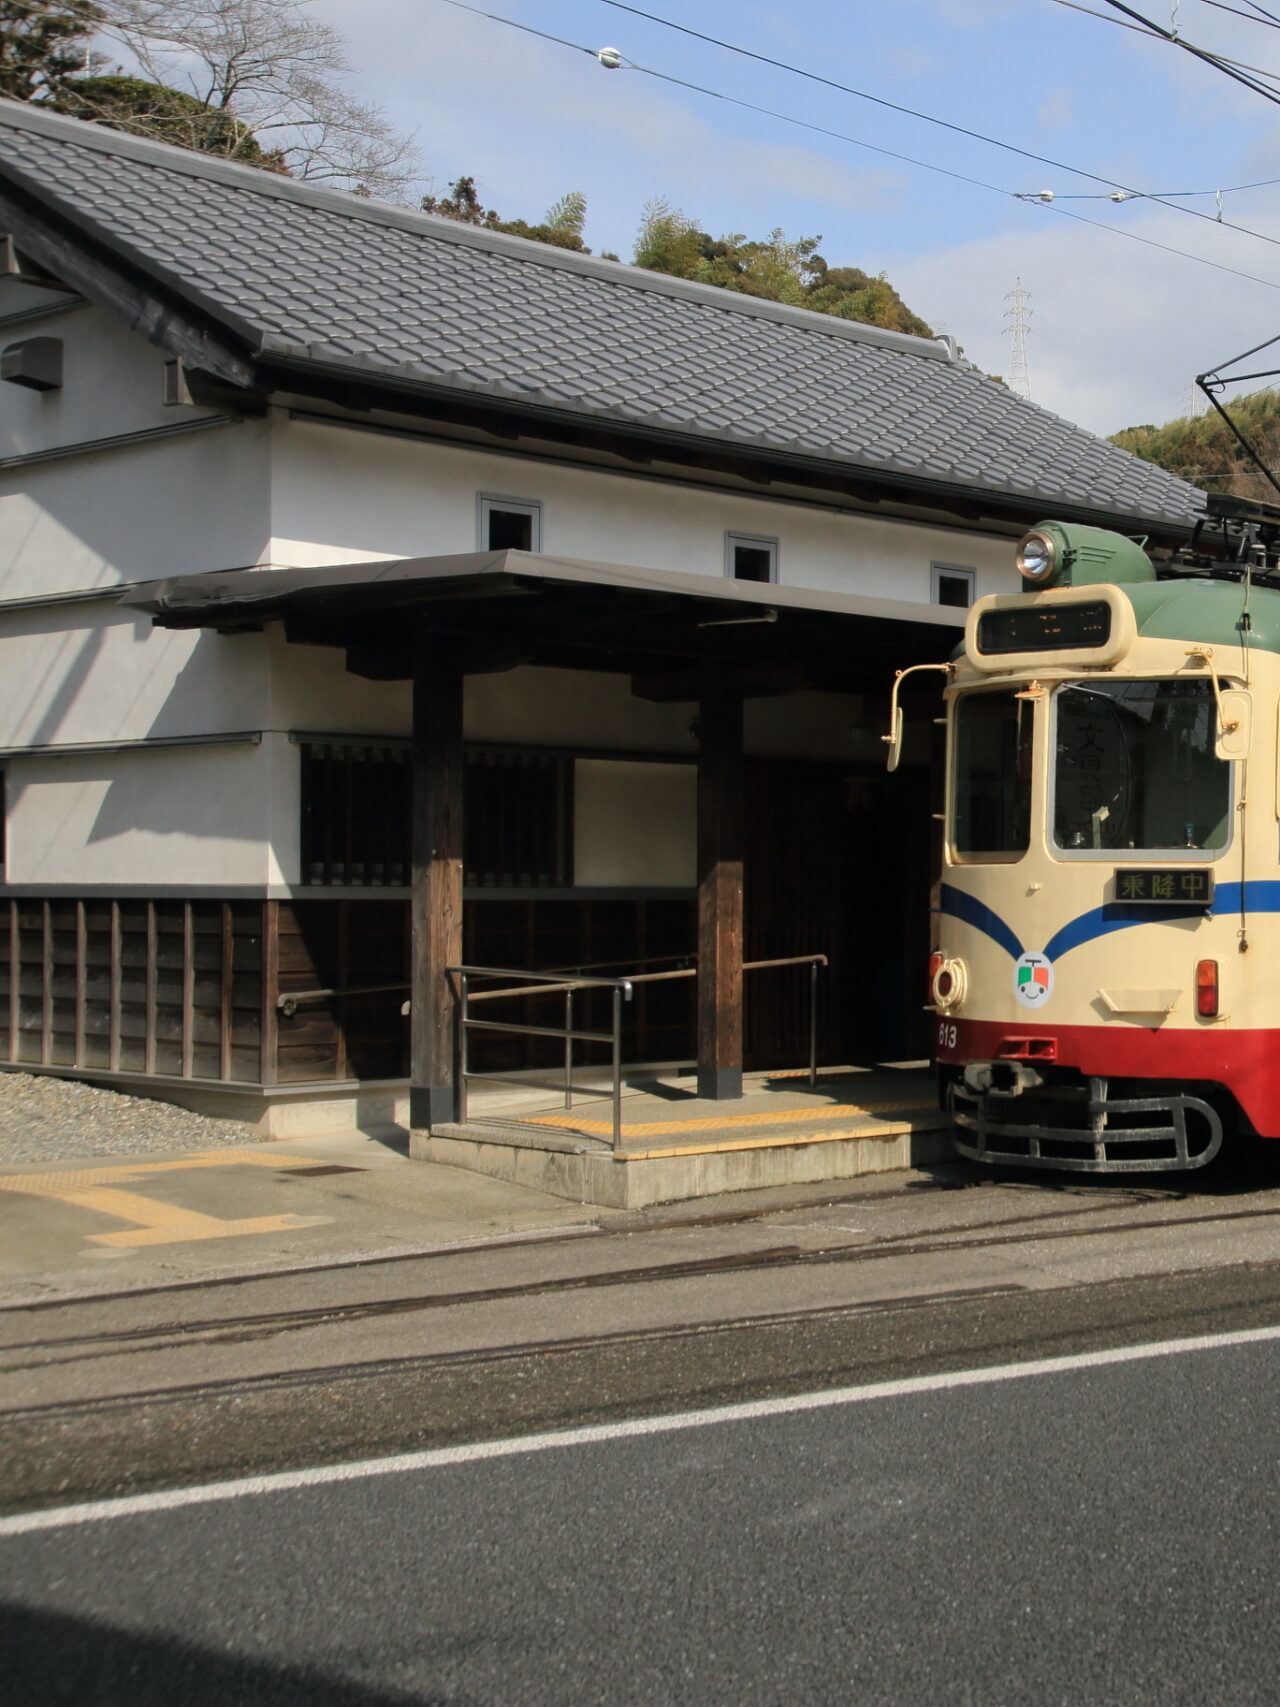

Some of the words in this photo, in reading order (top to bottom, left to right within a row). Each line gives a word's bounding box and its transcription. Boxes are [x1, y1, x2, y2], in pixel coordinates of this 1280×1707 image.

[1121, 873, 1204, 899] 乗降中
[938, 1022, 958, 1048] 613
